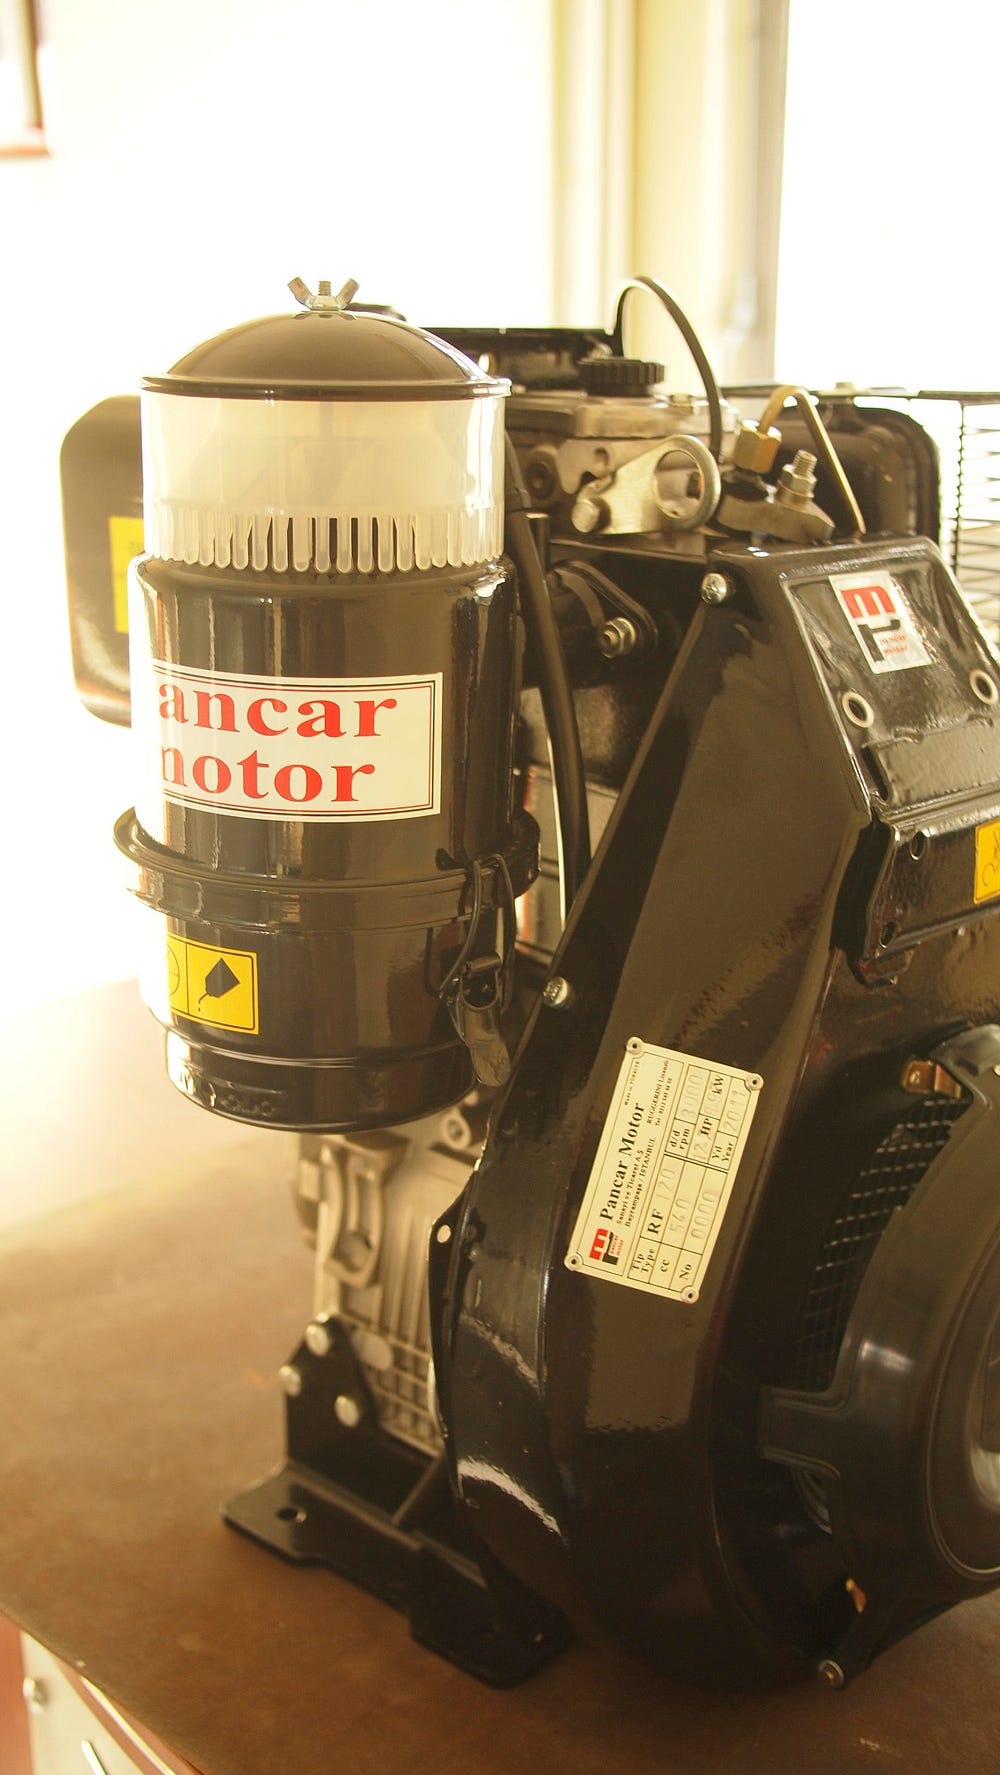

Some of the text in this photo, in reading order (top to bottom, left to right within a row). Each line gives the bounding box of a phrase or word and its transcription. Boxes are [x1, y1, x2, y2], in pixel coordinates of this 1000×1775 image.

[158, 683, 398, 738] ancar
[711, 1074, 725, 1094] kW
[699, 1117, 712, 1135] HP
[668, 1129, 680, 1147] d/d
[678, 1127, 692, 1150] rpm
[599, 1101, 645, 1220] Pancar Motor
[721, 1141, 733, 1162] Year
[626, 1162, 639, 1189] Ticaret
[647, 1208, 664, 1234] RF
[631, 1252, 644, 1271] Tip
[641, 1247, 657, 1274] Type
[659, 1259, 670, 1272] cc
[679, 1262, 692, 1280] No
